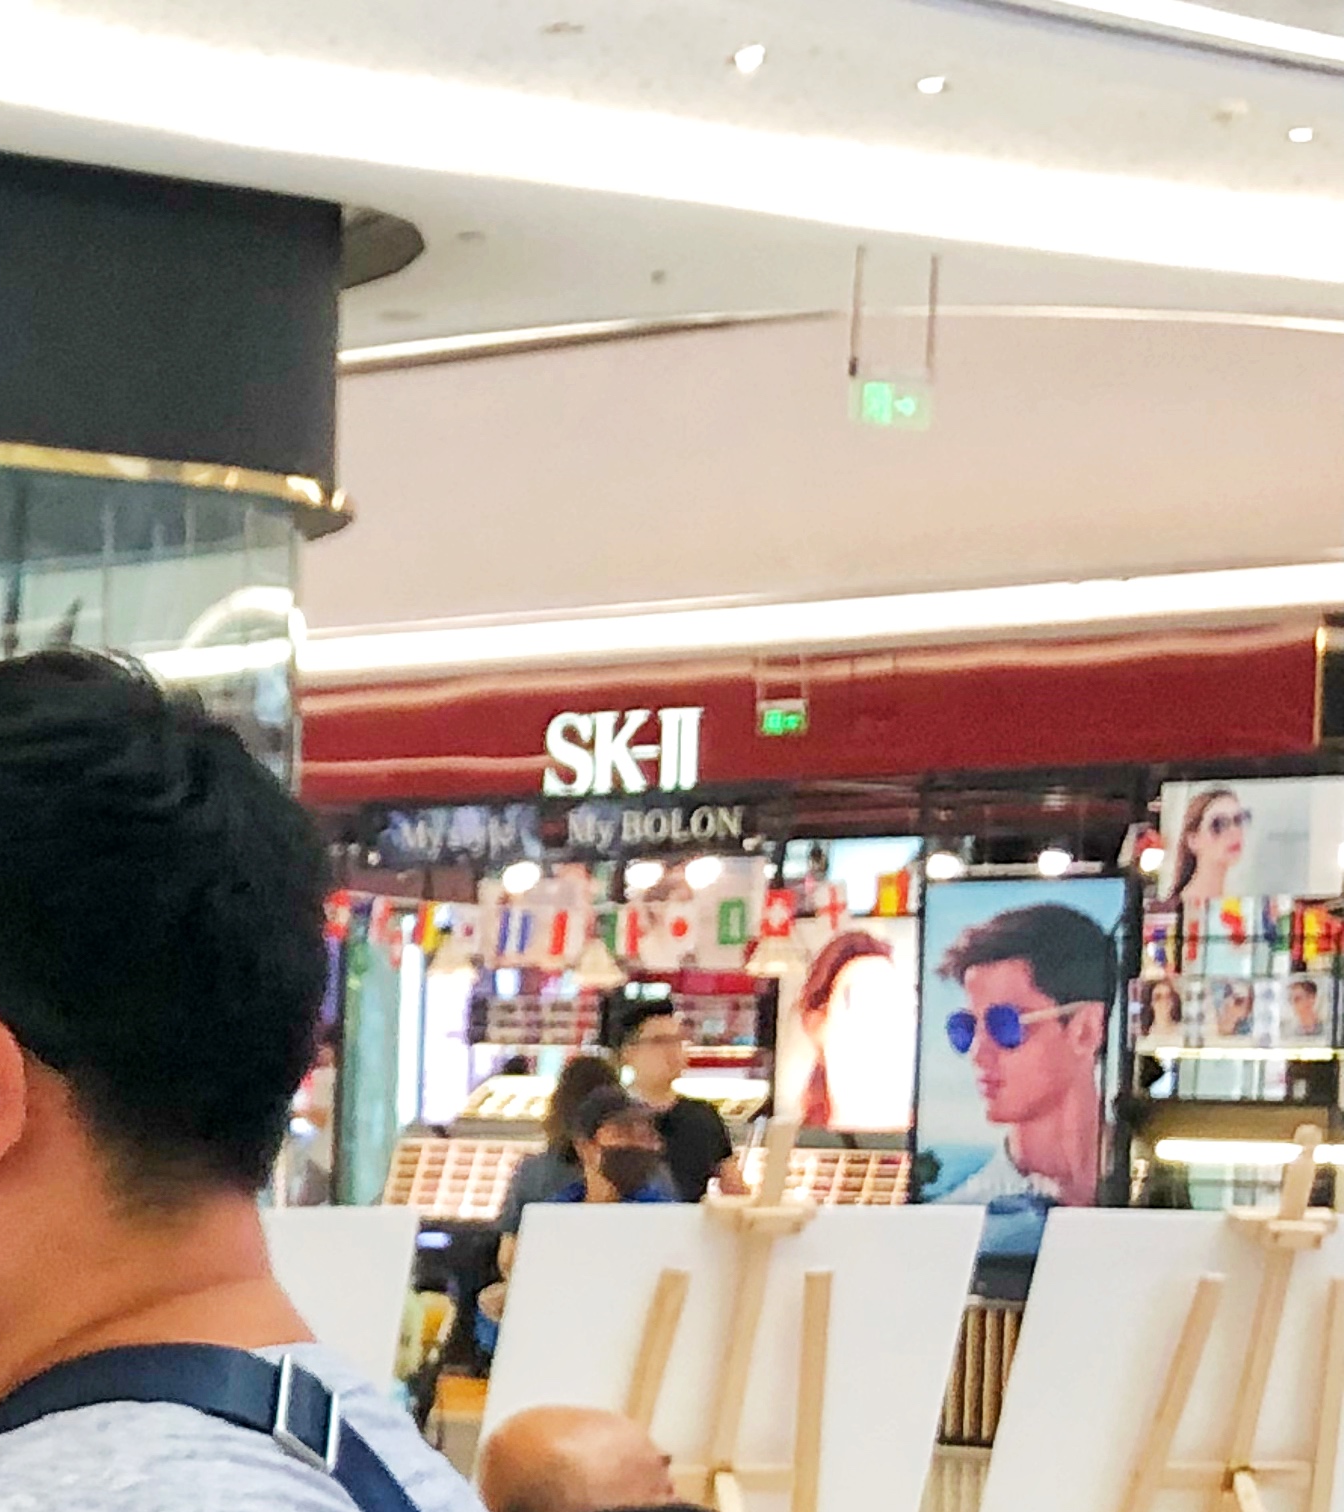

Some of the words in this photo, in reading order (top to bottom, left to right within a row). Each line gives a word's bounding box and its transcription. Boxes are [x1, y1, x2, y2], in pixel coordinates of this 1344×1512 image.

[543, 706, 703, 797] SK-II
[568, 808, 614, 851] My
[622, 804, 744, 843] BOLON
